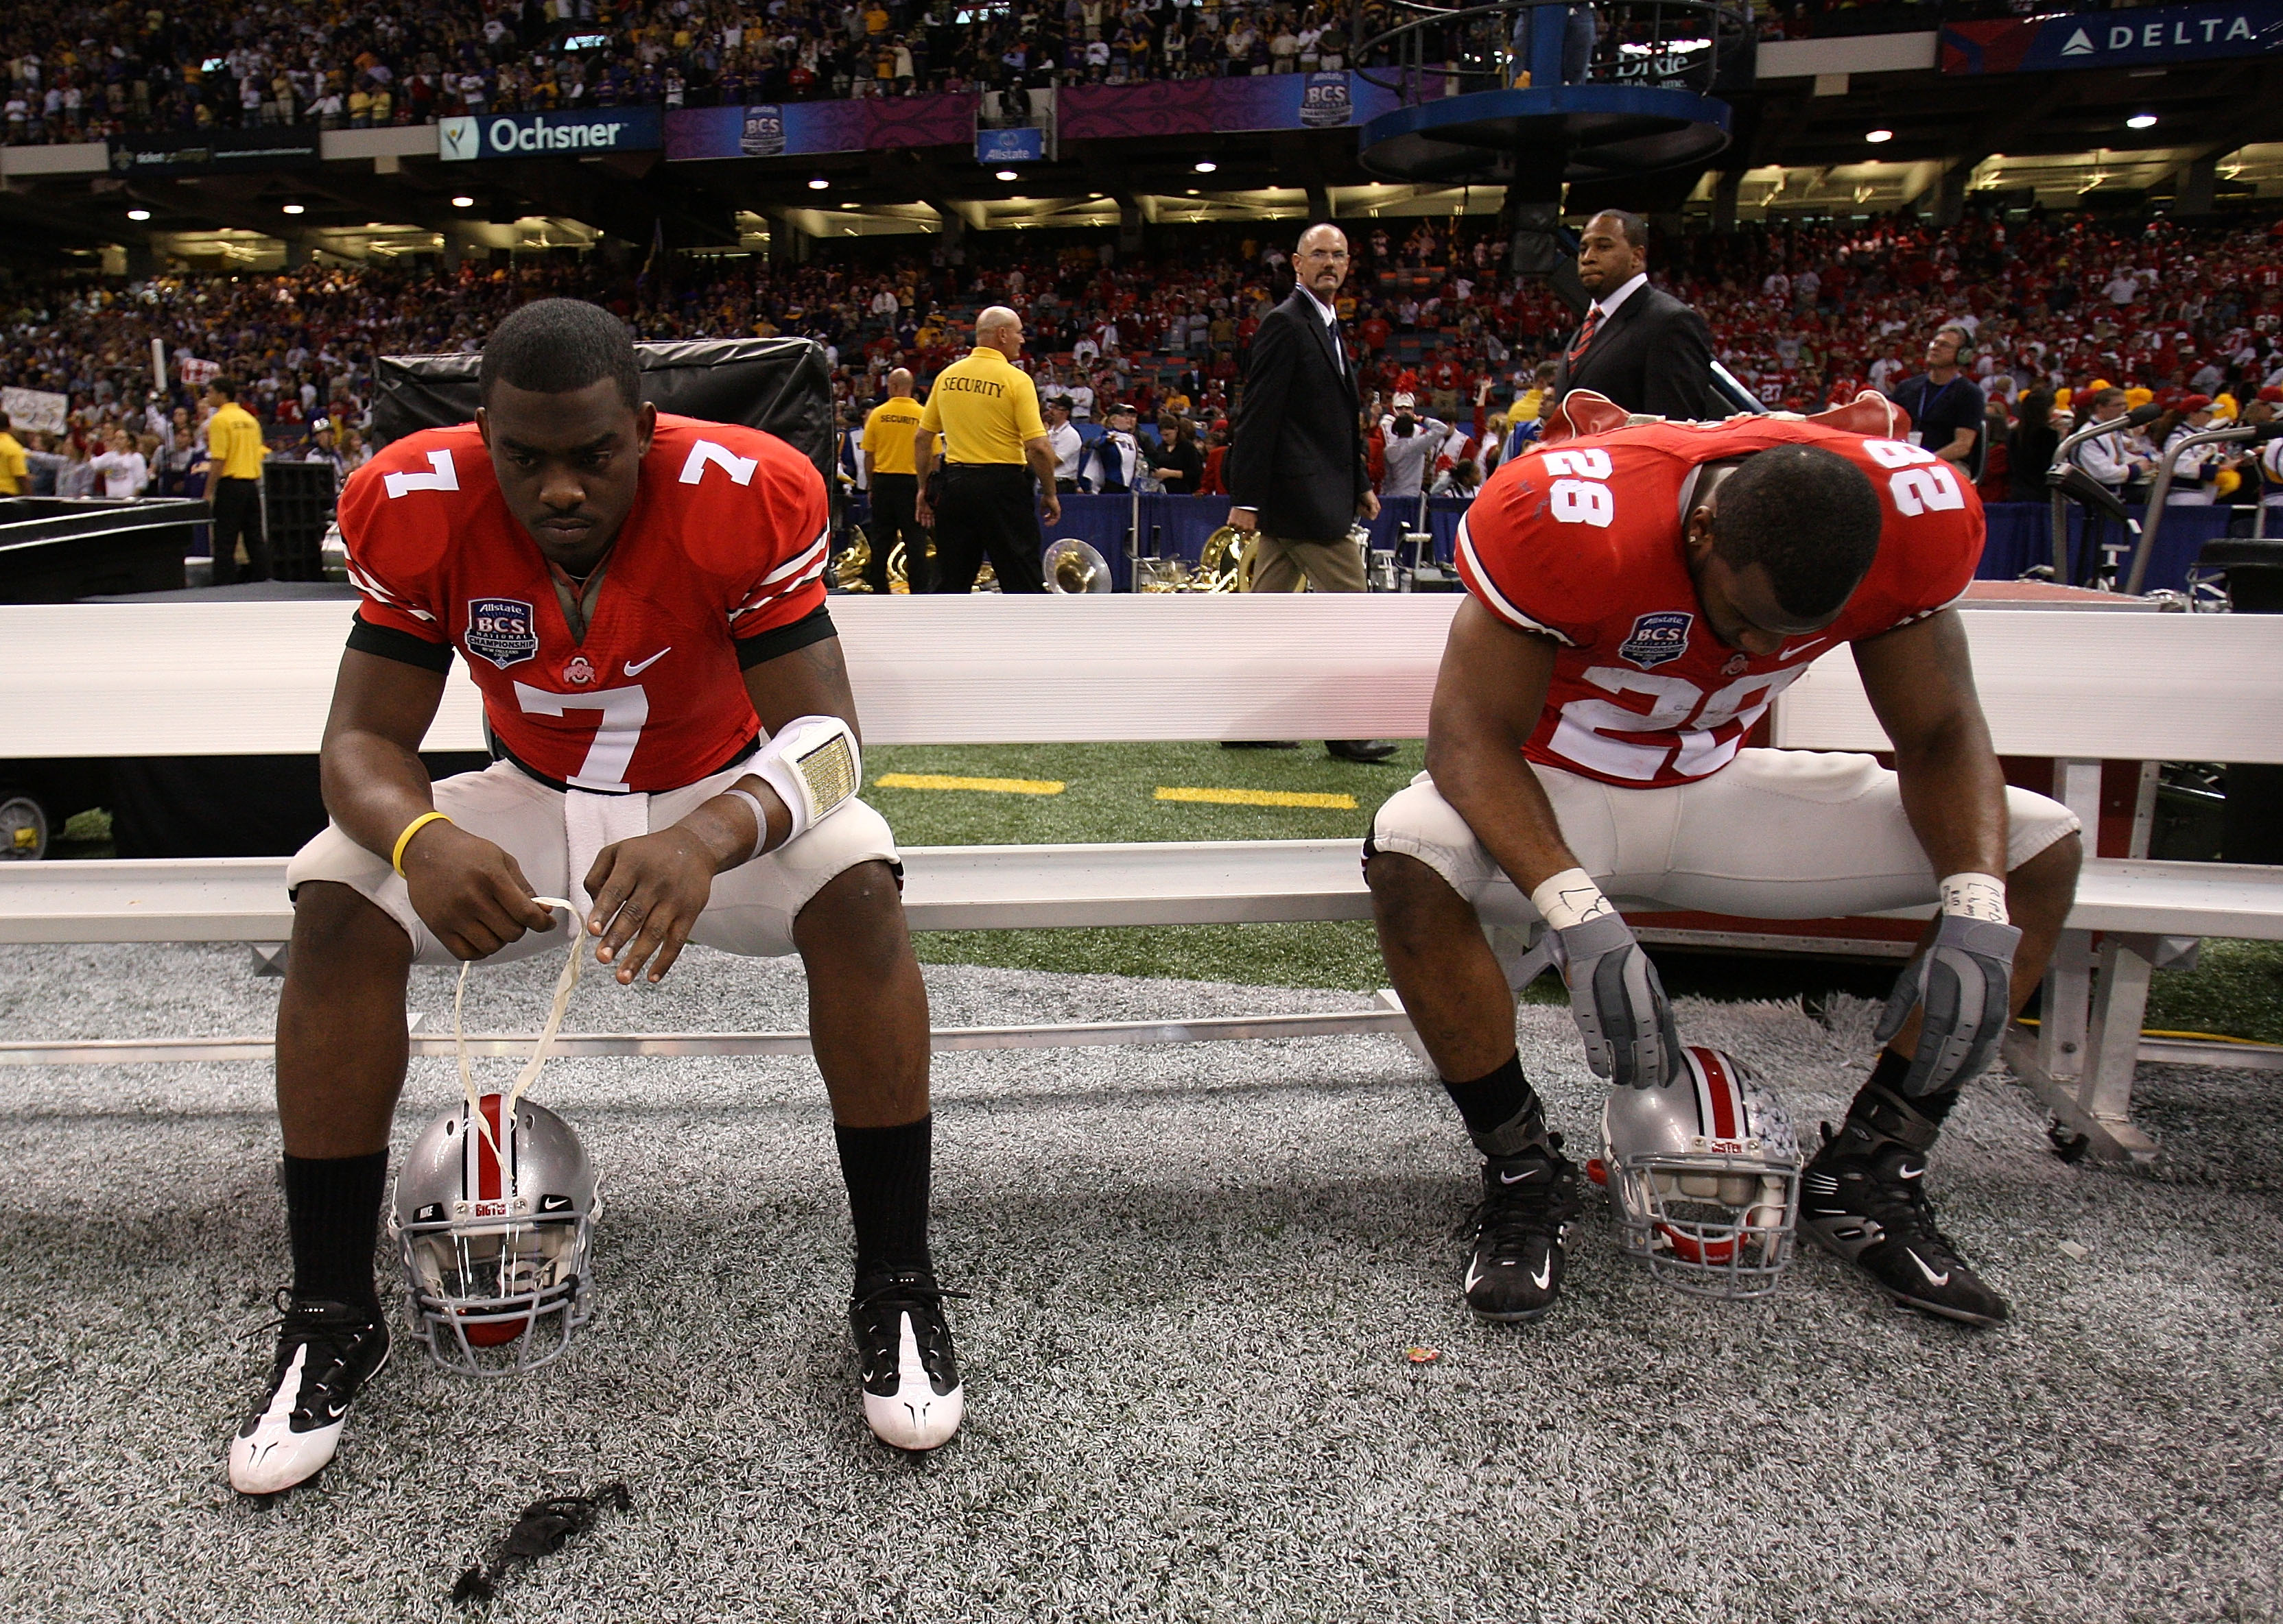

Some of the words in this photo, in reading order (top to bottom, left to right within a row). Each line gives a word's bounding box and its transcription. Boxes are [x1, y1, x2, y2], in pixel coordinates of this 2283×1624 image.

[2108, 16, 2252, 50] DELTA
[1307, 86, 1346, 103] BCS
[488, 116, 622, 153] Ochsner
[745, 118, 780, 134] BCS
[985, 147, 1030, 160] Allstate
[943, 377, 1005, 398] SECURITY
[1761, 384, 1783, 402] 27
[678, 439, 758, 486] 7
[383, 449, 460, 499] 7
[1862, 440, 1965, 517] 28
[1541, 448, 1615, 528] 28
[480, 604, 523, 614] Allstate
[477, 617, 526, 634] BCS
[1636, 628, 1682, 641] BCS
[469, 637, 534, 648] CHAMPIONSHIP
[477, 632, 528, 640] NATIONAL
[513, 680, 649, 793] 7
